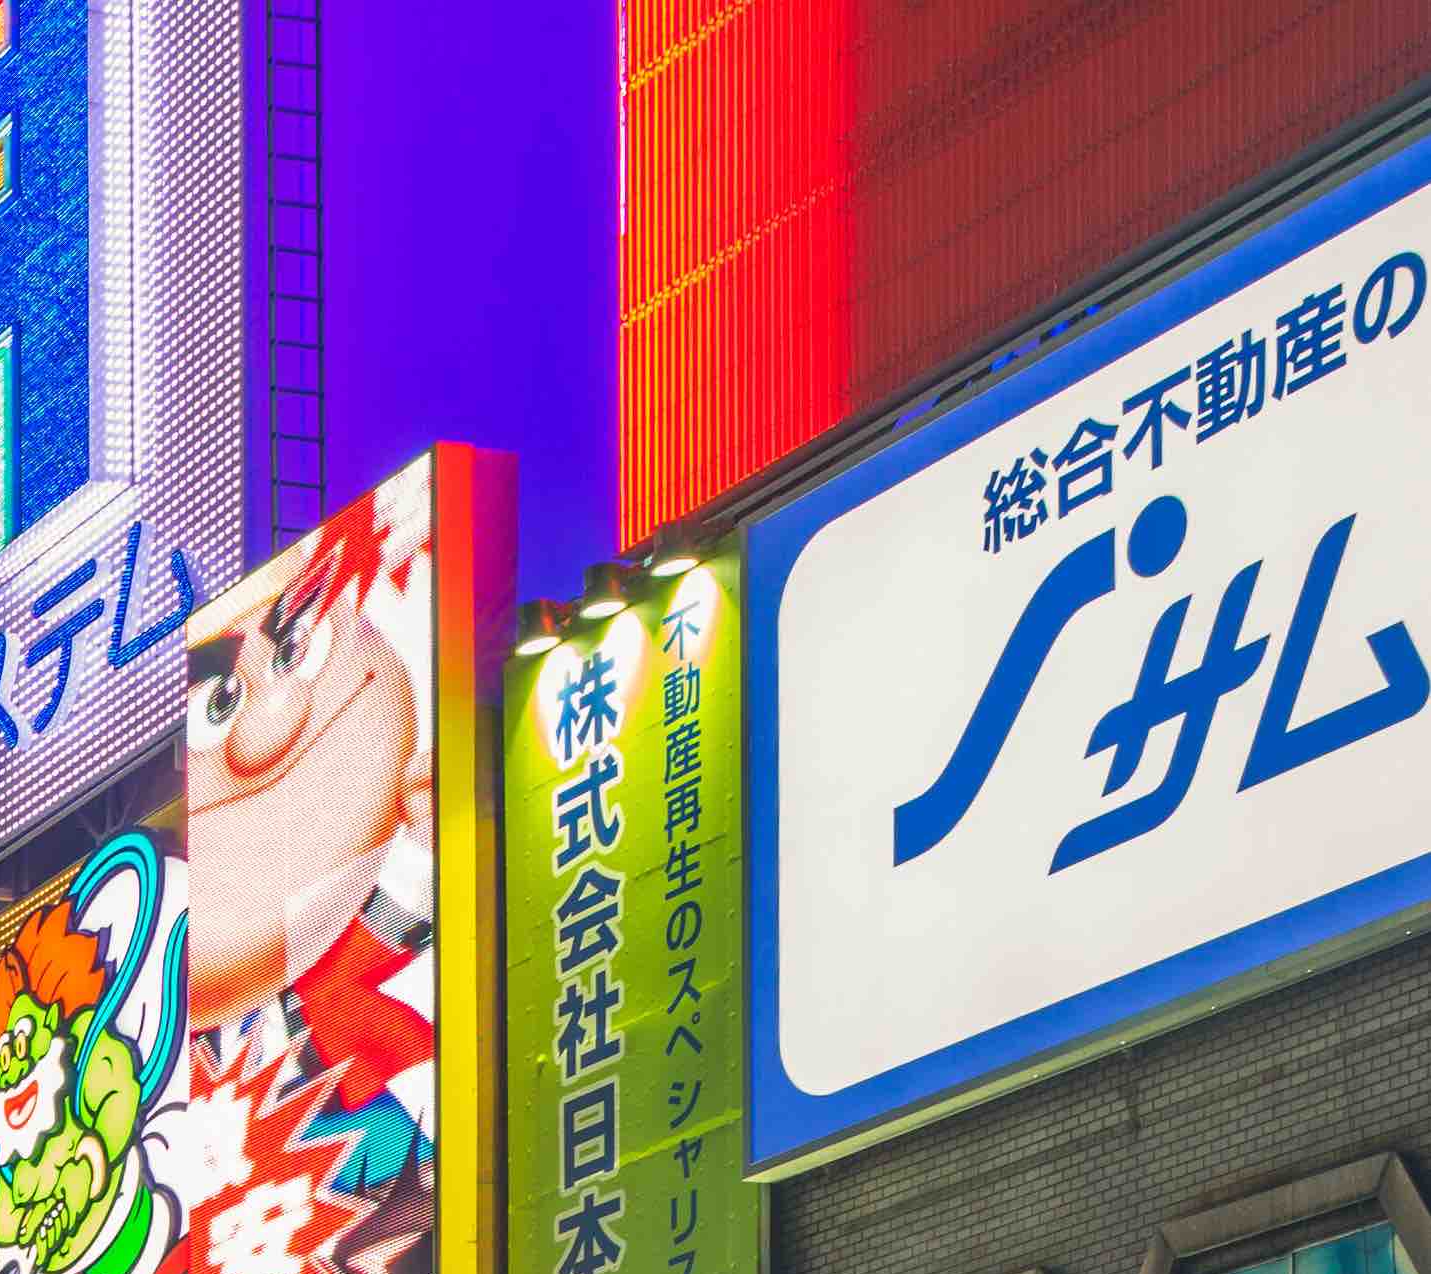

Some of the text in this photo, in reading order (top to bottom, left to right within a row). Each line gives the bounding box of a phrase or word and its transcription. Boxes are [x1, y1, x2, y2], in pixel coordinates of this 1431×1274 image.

[981, 248, 1430, 556] 総合不動産の
